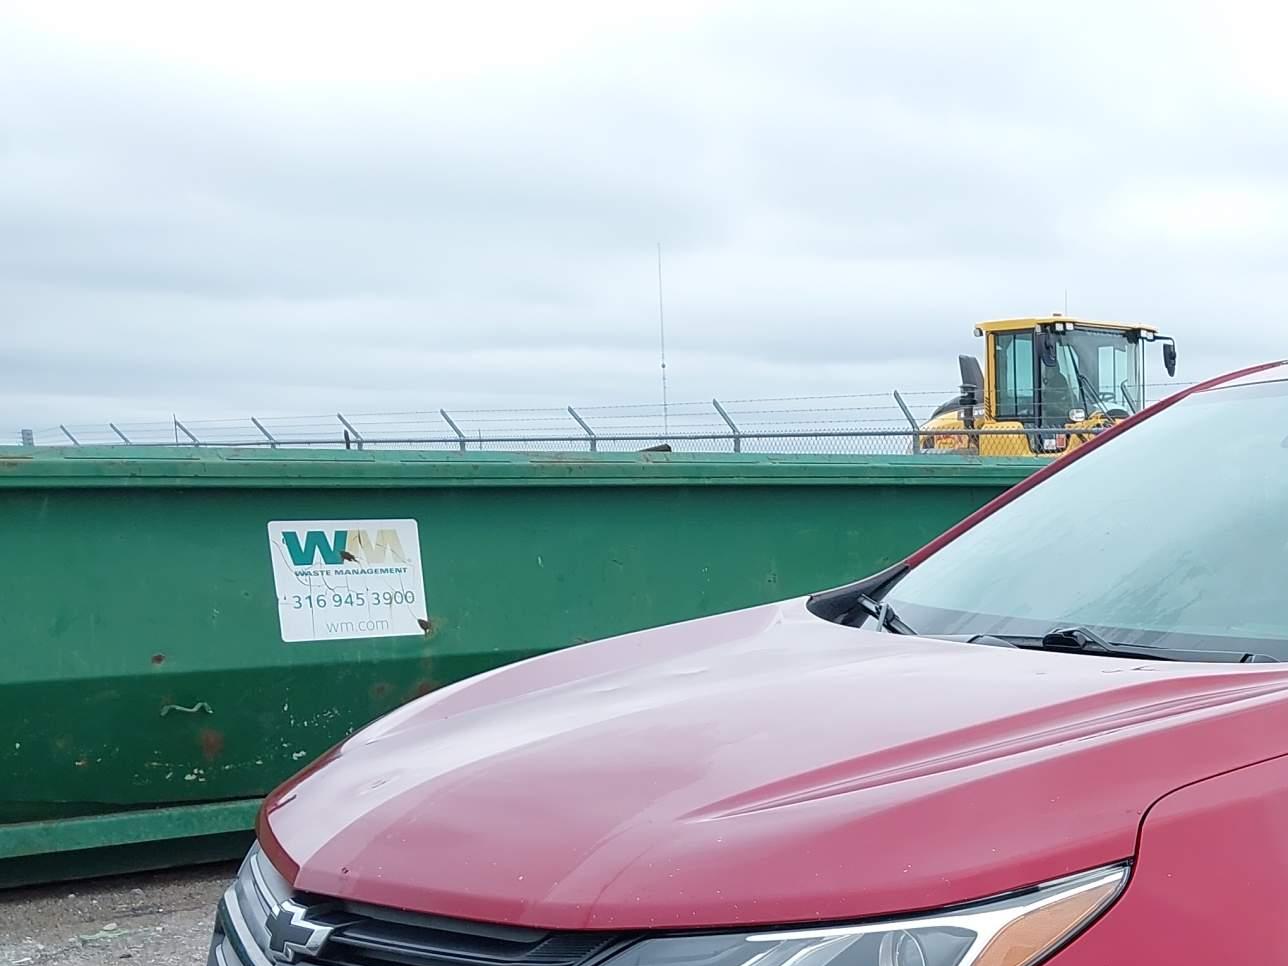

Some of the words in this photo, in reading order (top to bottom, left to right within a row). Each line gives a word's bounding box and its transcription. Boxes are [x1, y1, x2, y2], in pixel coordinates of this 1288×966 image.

[282, 529, 406, 566] WM
[294, 569, 331, 577] WASTE
[334, 567, 408, 576] MANAGEMENT
[292, 594, 327, 609] 316
[332, 592, 365, 608] 945
[372, 590, 415, 606] 3900
[326, 619, 389, 633] wm.com
